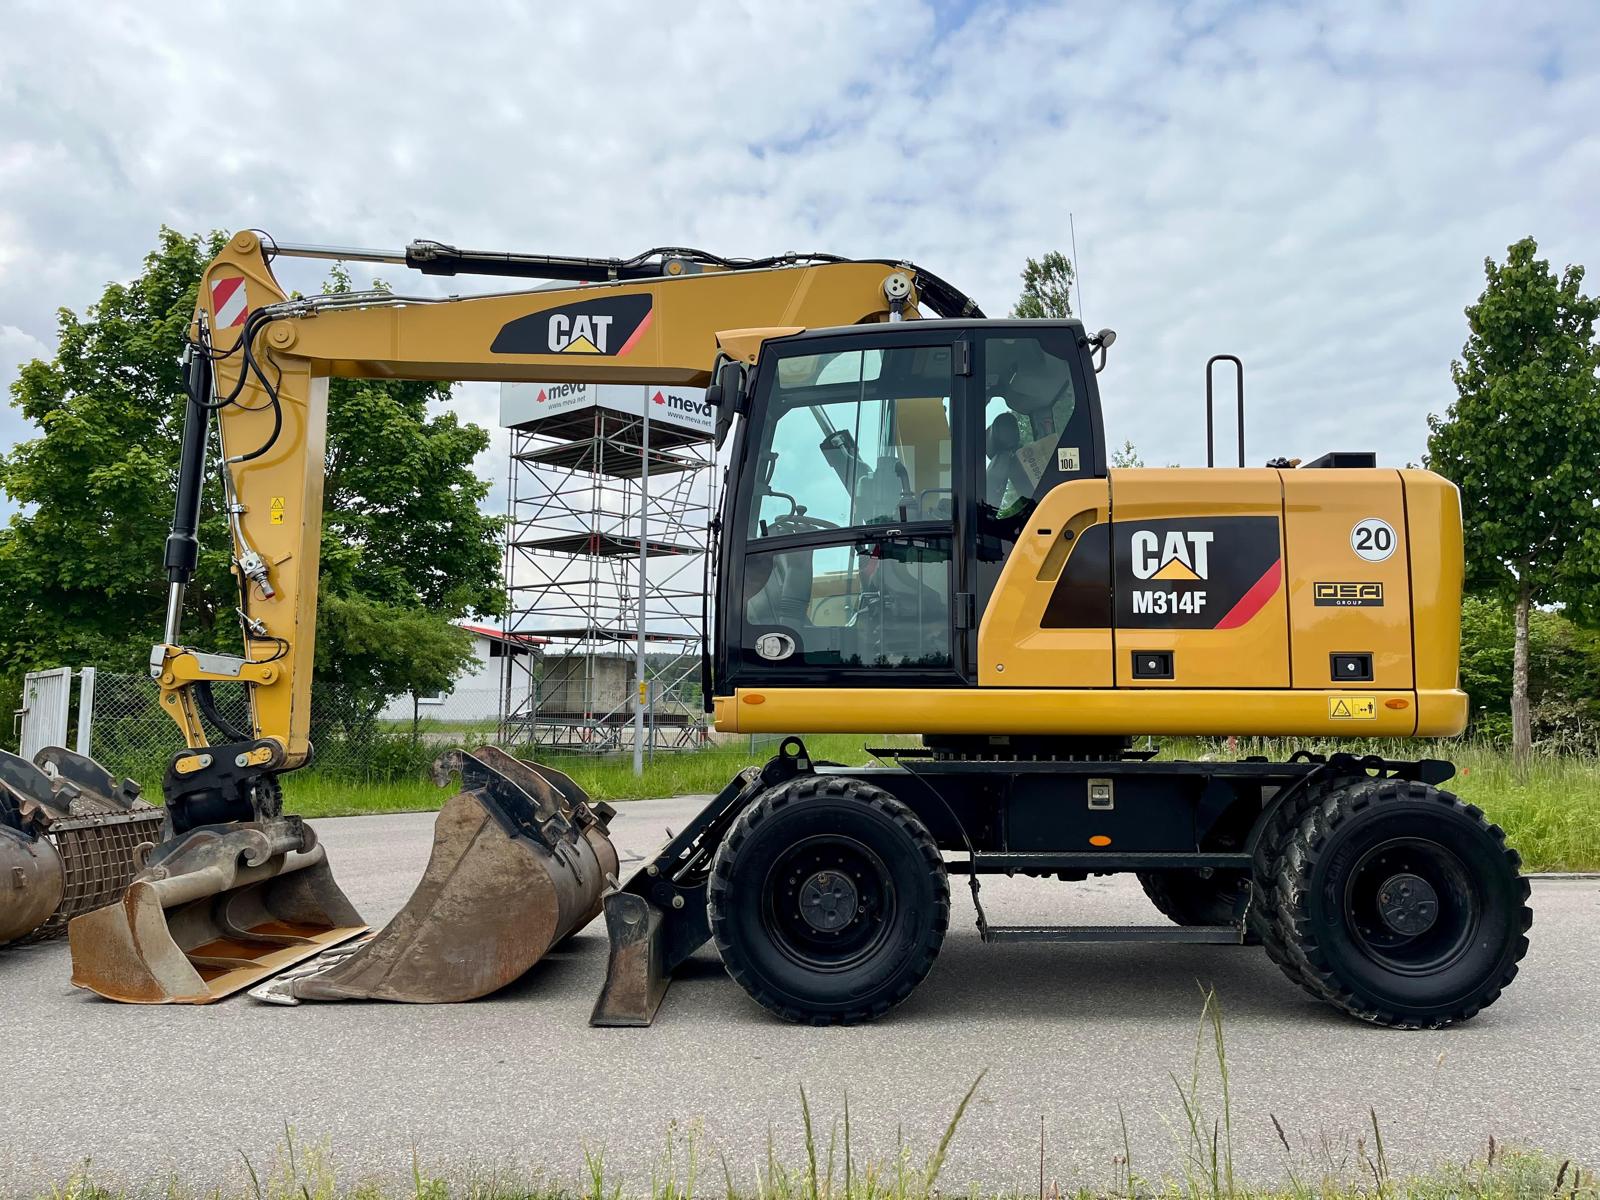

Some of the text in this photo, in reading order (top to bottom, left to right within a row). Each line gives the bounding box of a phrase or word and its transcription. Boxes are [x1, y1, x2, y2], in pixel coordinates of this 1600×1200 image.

[547, 314, 613, 353] CAT
[549, 383, 586, 400] meva
[668, 395, 712, 417] meva
[1060, 459, 1073, 469] 100
[1356, 527, 1391, 551] 20
[1131, 530, 1214, 580] CAT
[1132, 590, 1207, 614] M314F
